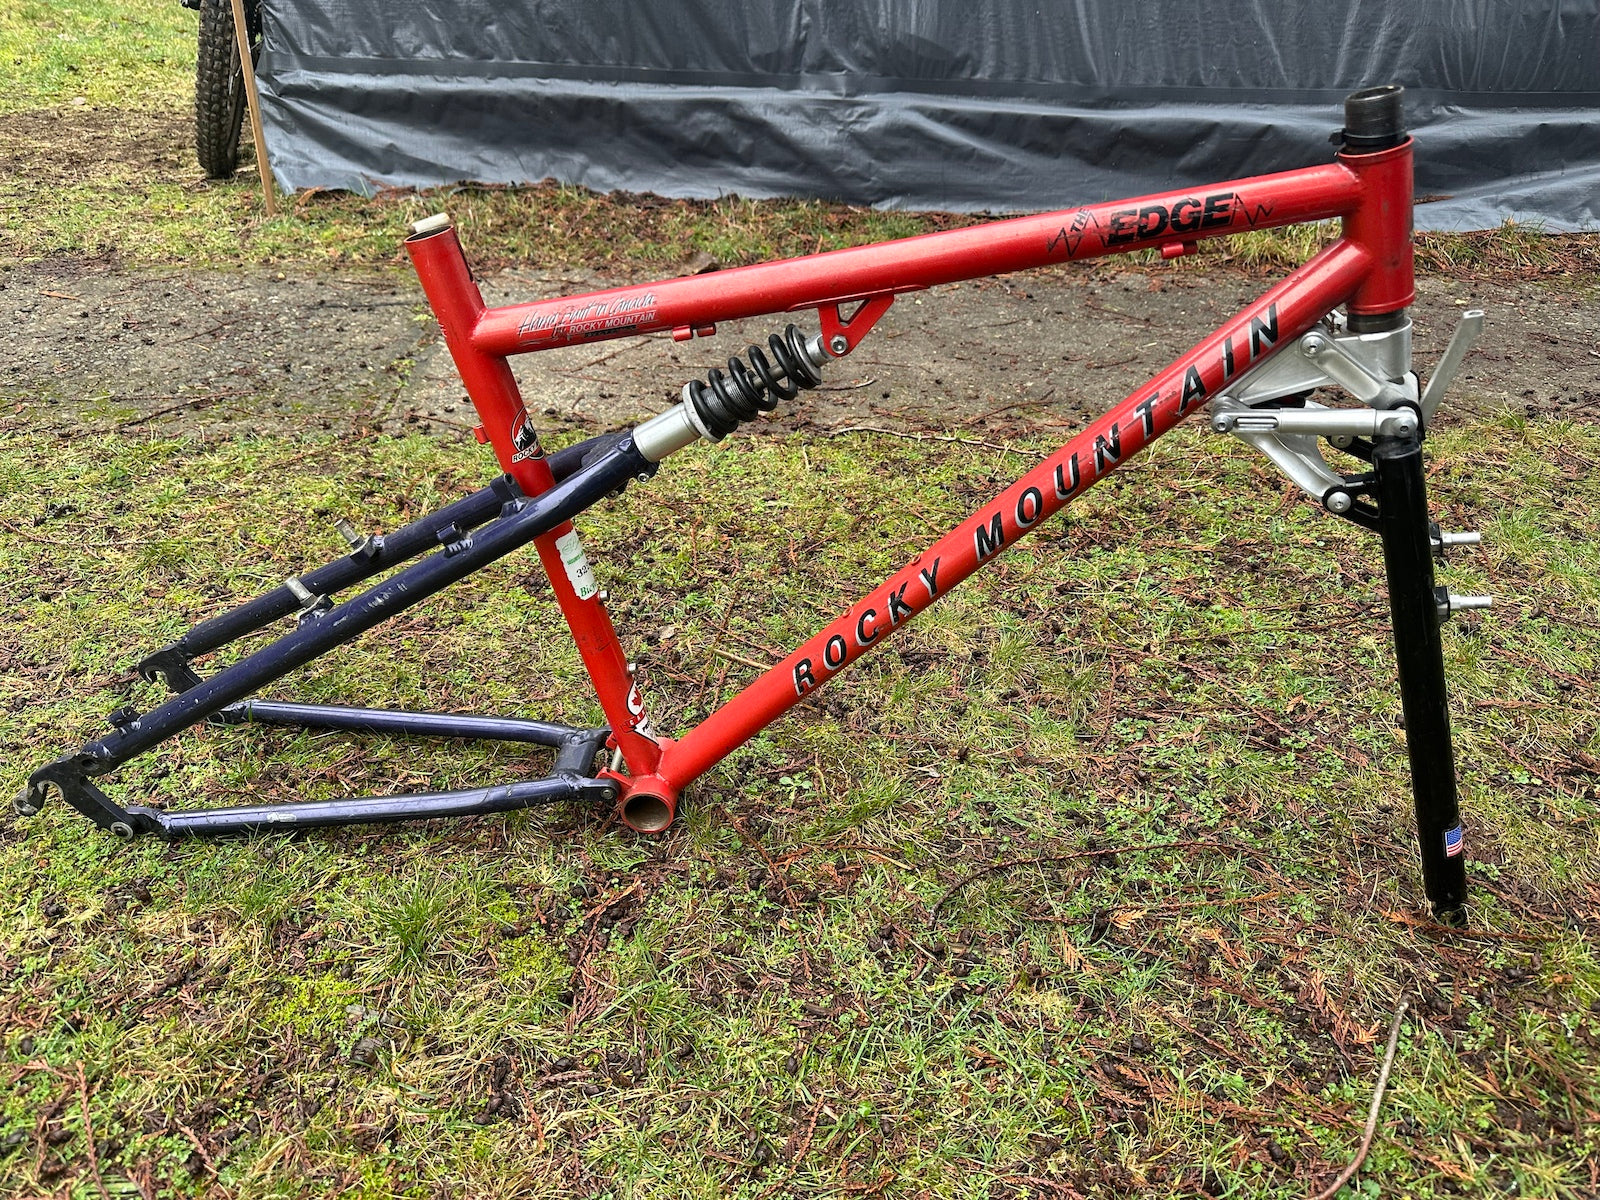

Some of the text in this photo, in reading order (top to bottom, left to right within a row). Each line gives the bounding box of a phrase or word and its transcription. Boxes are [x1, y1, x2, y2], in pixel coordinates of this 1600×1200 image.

[1070, 192, 1234, 245] THE EDGE
[569, 320, 604, 334] ROCKY
[604, 311, 656, 328] MOUNTAIN
[792, 302, 1280, 697] ROCKY MOUNTAIN
